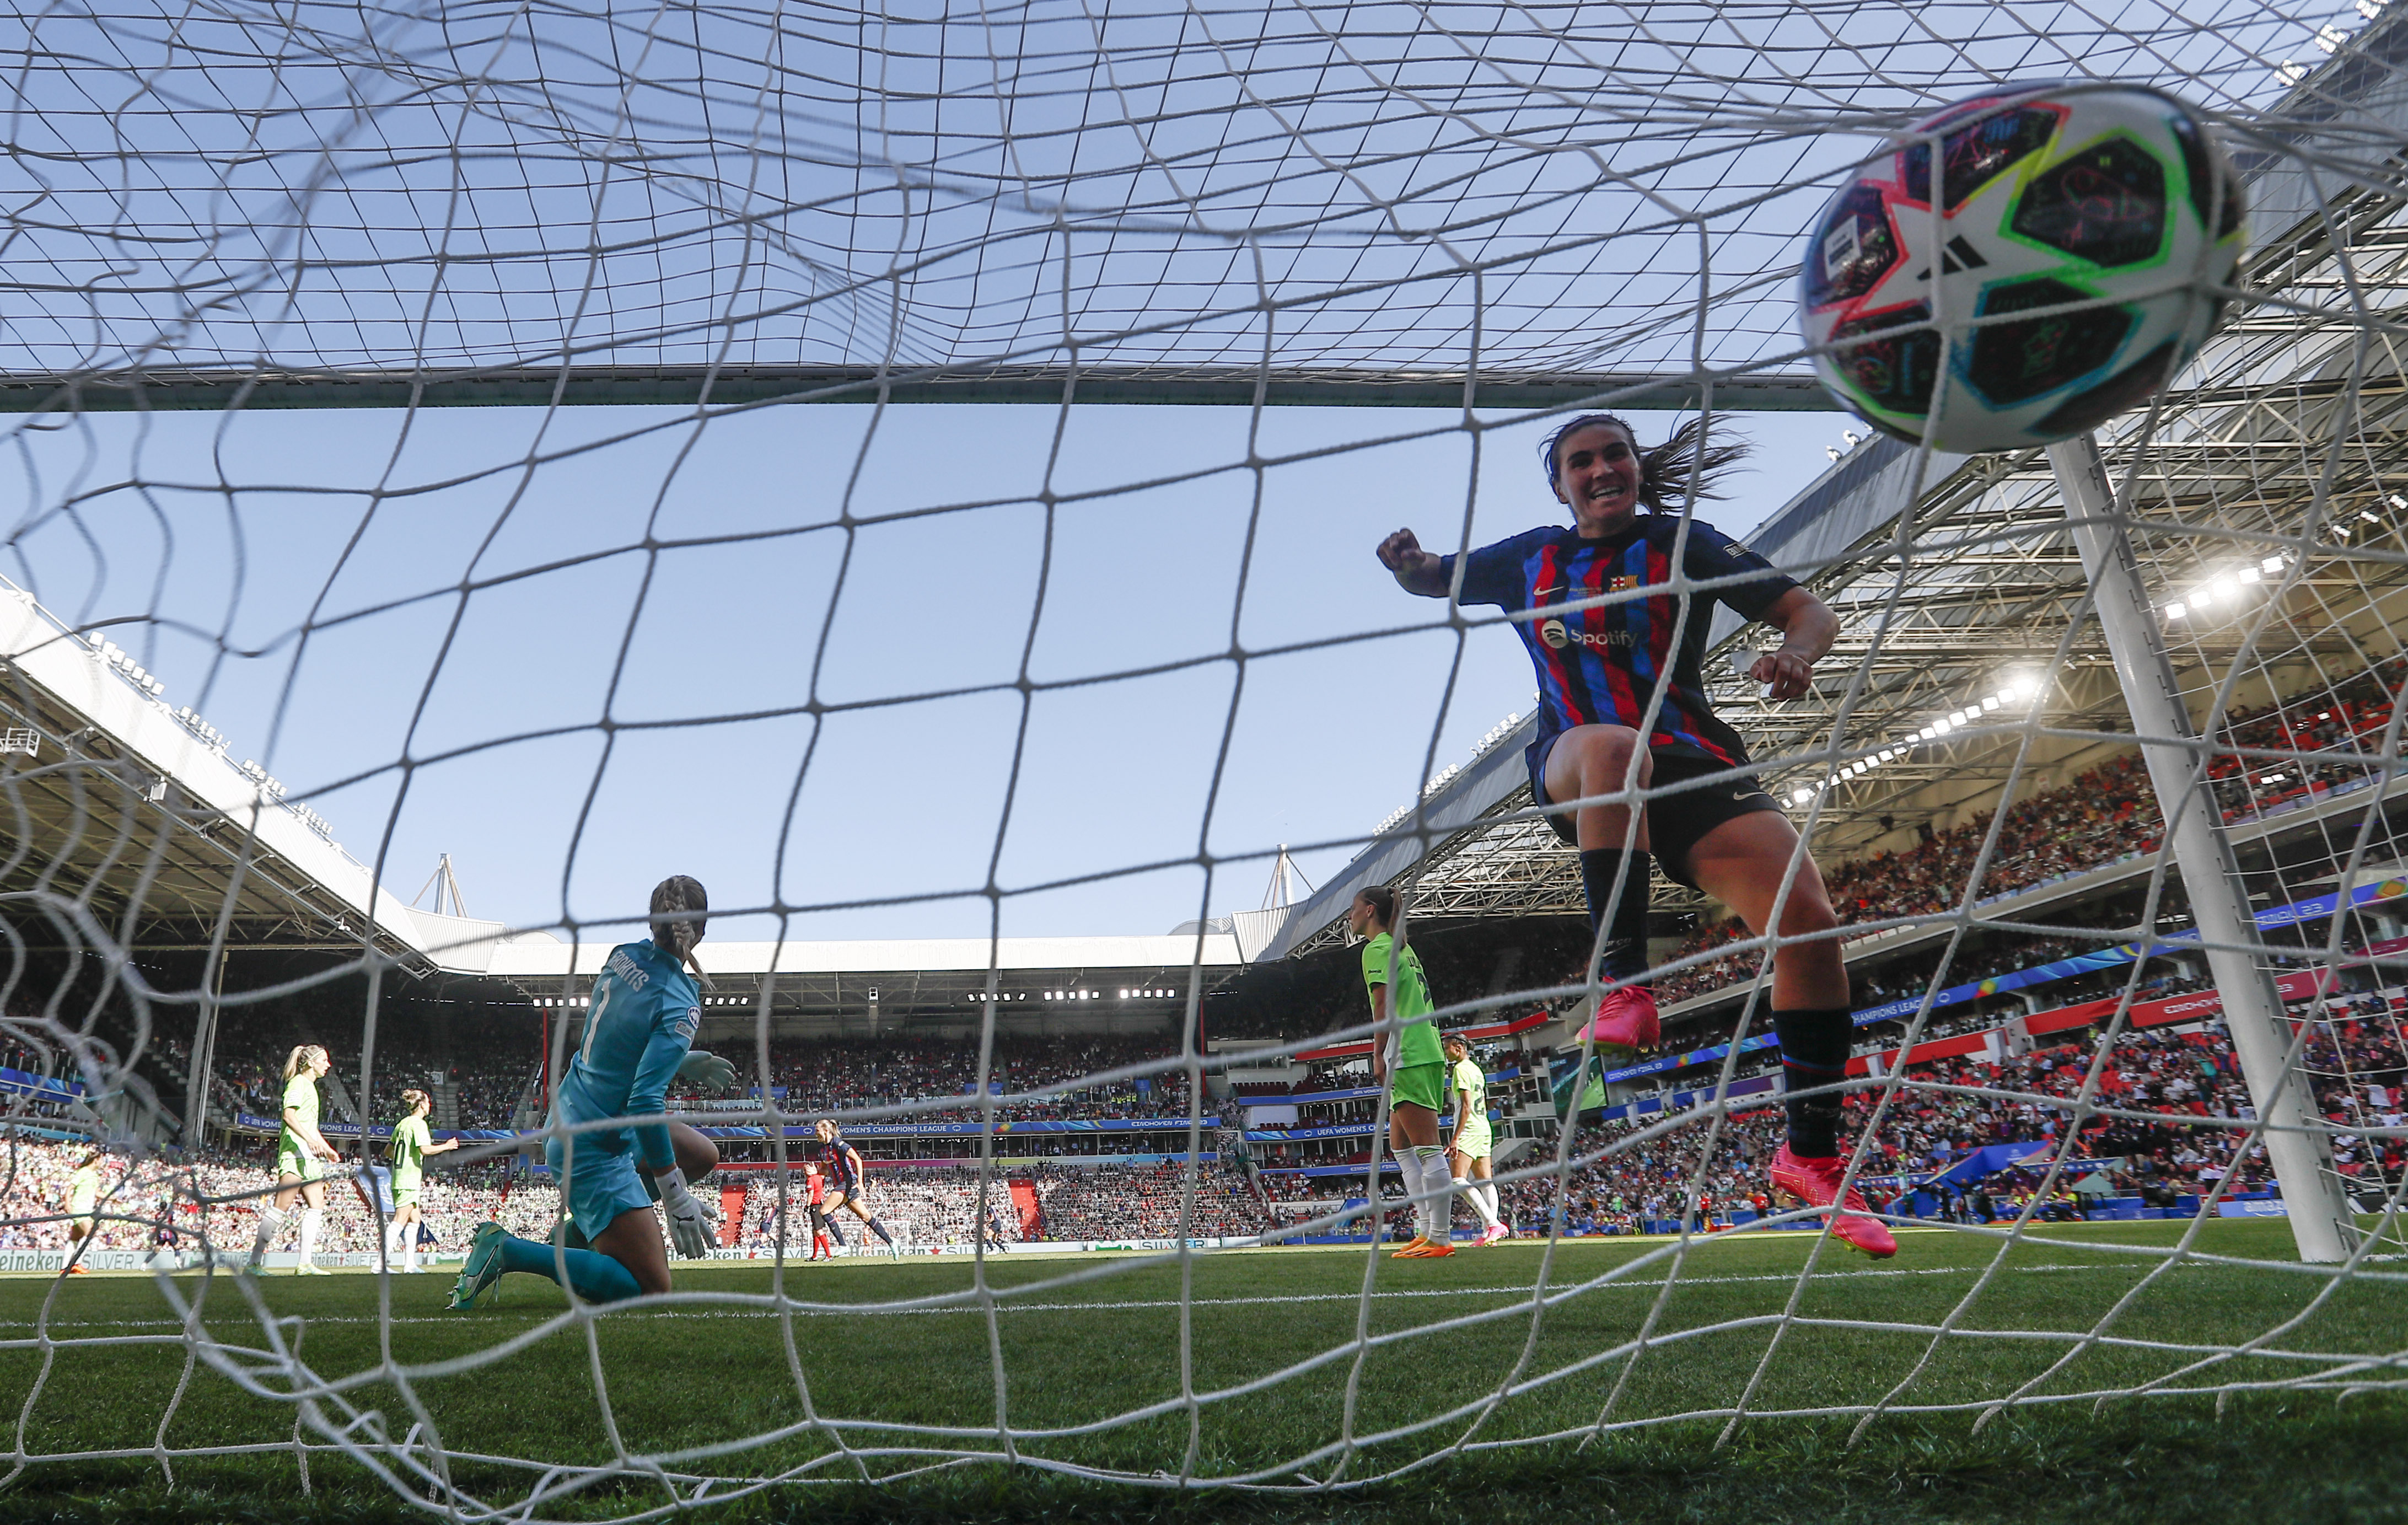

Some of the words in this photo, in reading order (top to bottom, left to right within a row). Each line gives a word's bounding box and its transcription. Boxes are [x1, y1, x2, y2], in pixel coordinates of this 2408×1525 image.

[1571, 629, 1638, 648] Spotify
[2300, 903, 2324, 915] 23
[1851, 1006, 1898, 1024] HAMPIONS
[1898, 999, 1922, 1013] LEAG
[2164, 996, 2222, 1014] EINDHOVE
[582, 978, 612, 1066] 1
[1317, 1128, 1334, 1136] UEFA
[1334, 1125, 1367, 1135] WOMEN'S
[2243, 1200, 2286, 1212] amaz
[0, 1250, 63, 1271] eineken
[83, 1254, 134, 1270] SILVER
[218, 1254, 249, 1268] SILVE
[311, 1253, 338, 1266] eineken
[666, 1249, 741, 1261] Heeken
